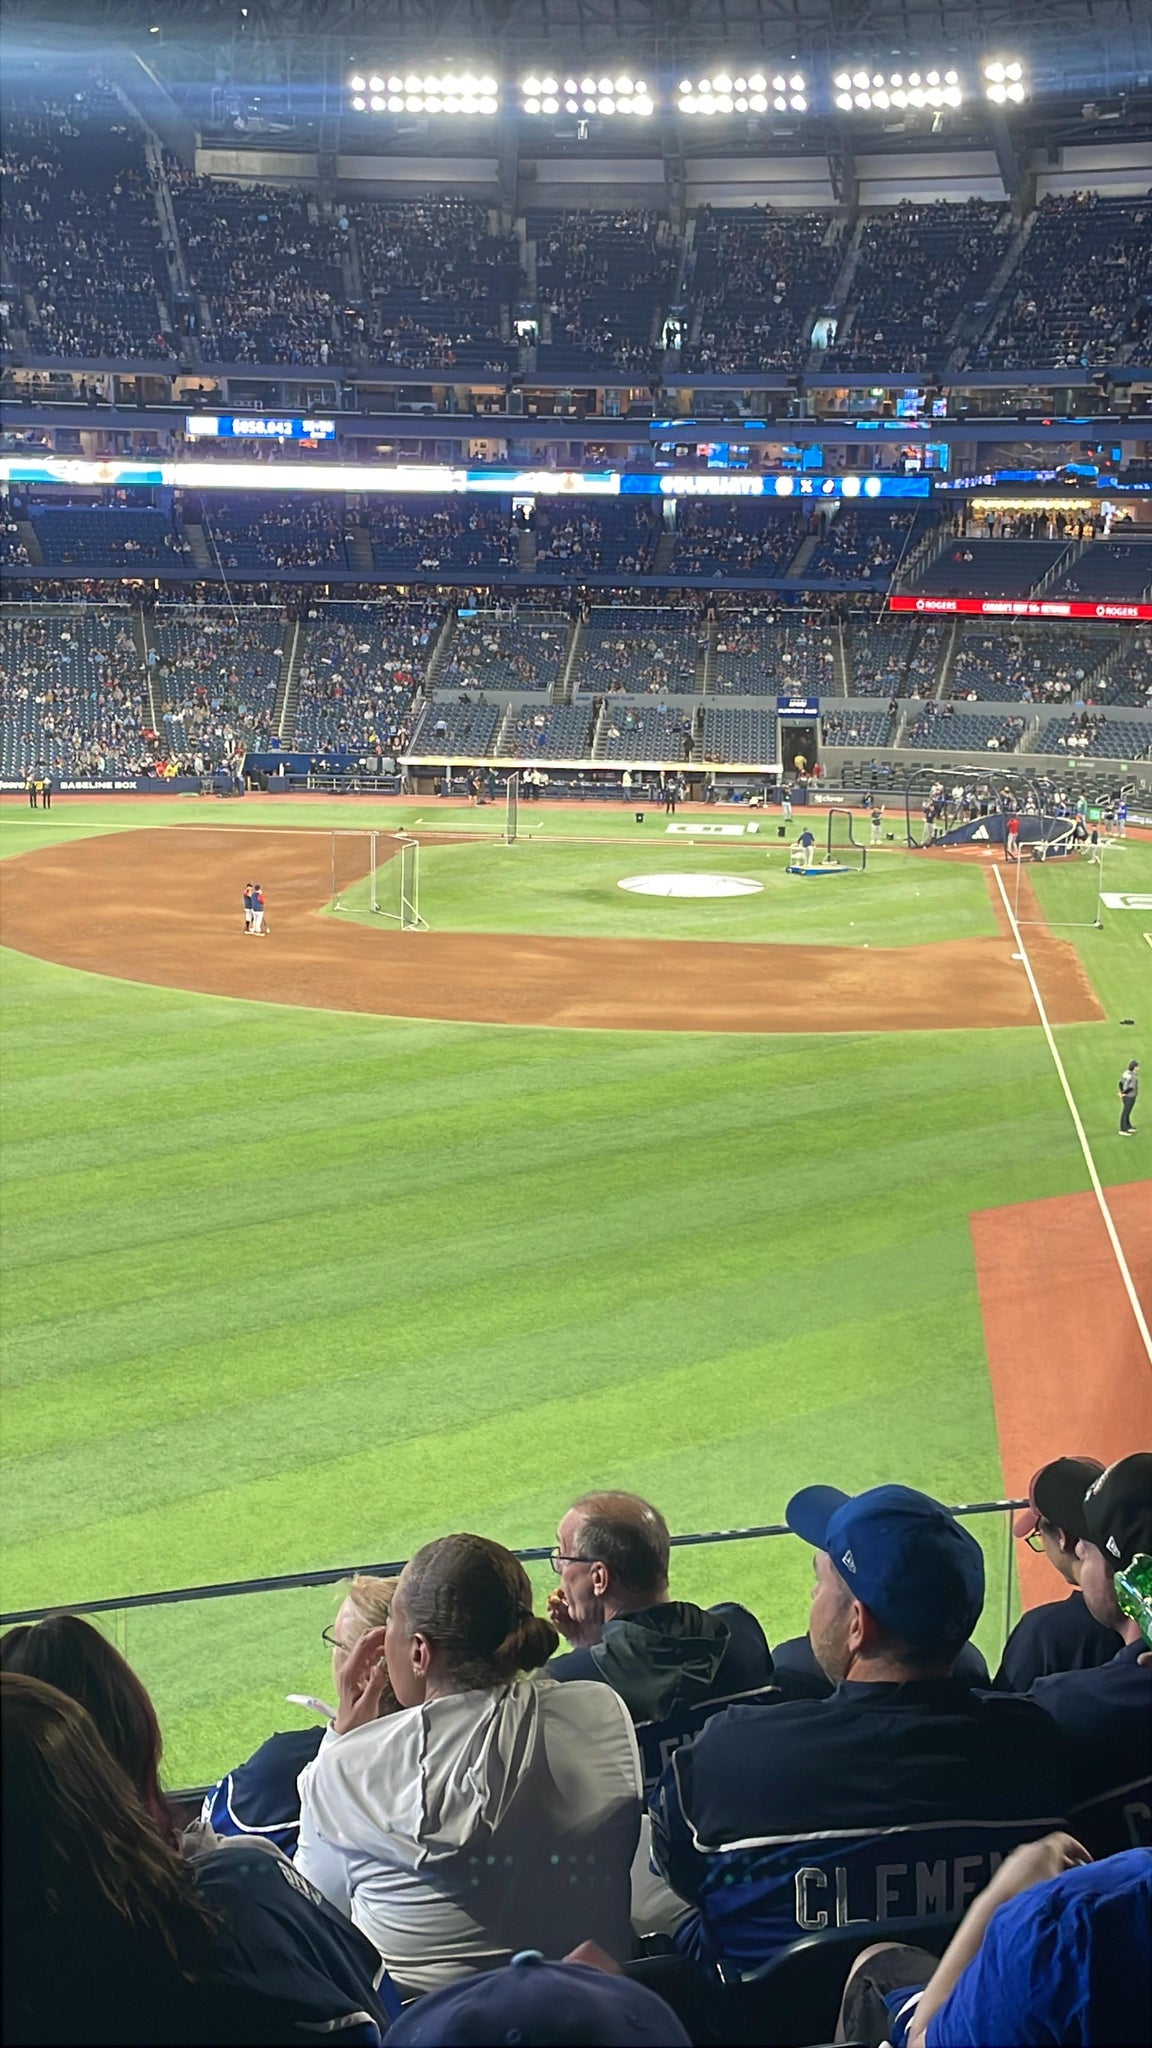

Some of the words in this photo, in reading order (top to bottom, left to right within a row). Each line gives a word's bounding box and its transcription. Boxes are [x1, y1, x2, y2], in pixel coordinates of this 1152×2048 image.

[925, 601, 957, 610] ROGERS
[1105, 606, 1138, 616] ROGERS
[60, 781, 112, 789] BASELINE
[114, 781, 137, 789] BOX
[795, 1852, 1004, 1930] CLEME
